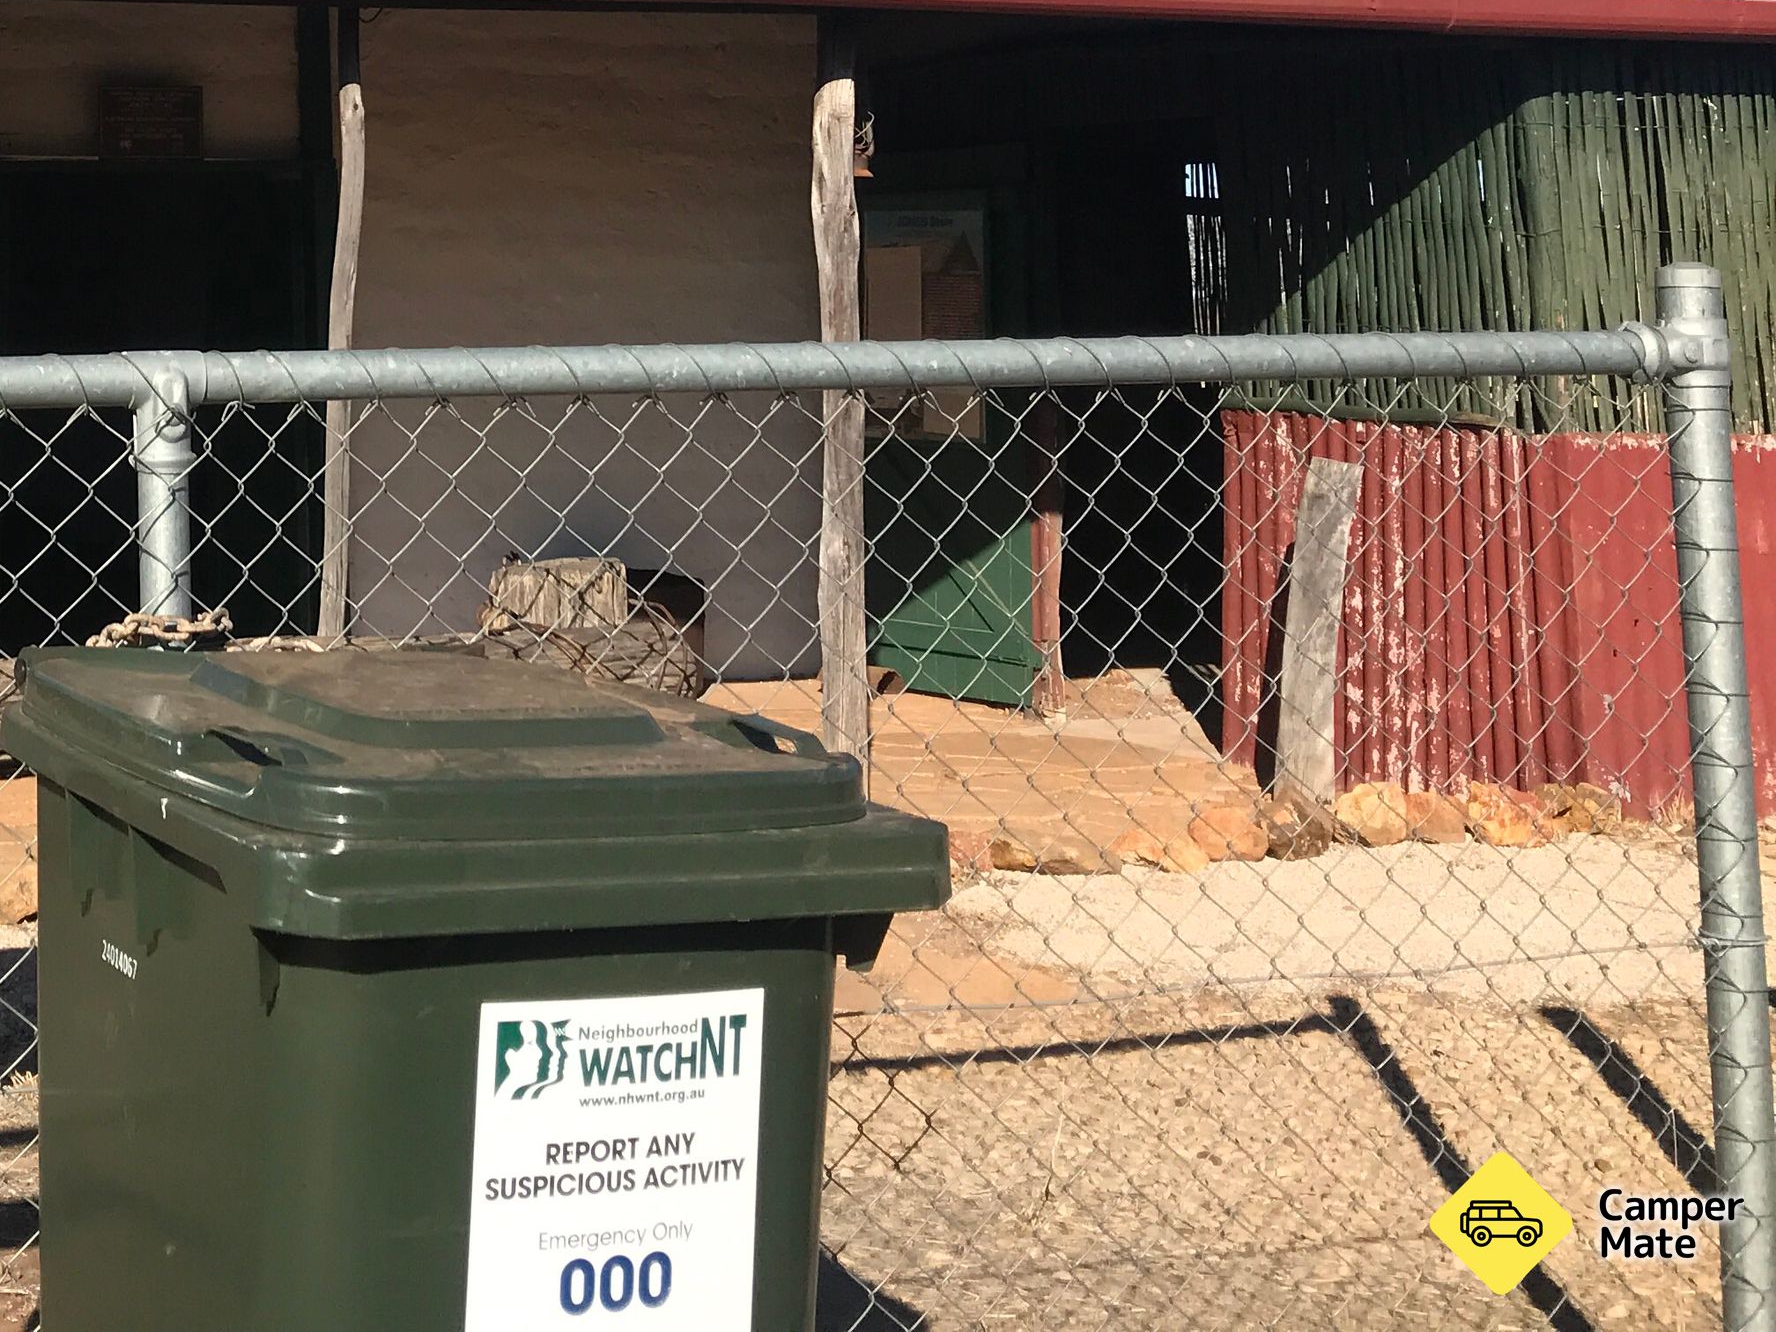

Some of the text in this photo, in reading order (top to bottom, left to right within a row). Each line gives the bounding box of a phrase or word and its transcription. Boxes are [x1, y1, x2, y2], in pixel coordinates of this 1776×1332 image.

[578, 1019, 698, 1044] Neighbourhood
[579, 1087, 705, 1107] www.nhwnt.org.au
[545, 1132, 696, 1166] REPORT ANY
[484, 1158, 745, 1201] SUSPICIOUS ACTIVITY
[538, 1220, 694, 1252] Emergency Only
[559, 1251, 672, 1316] 000
